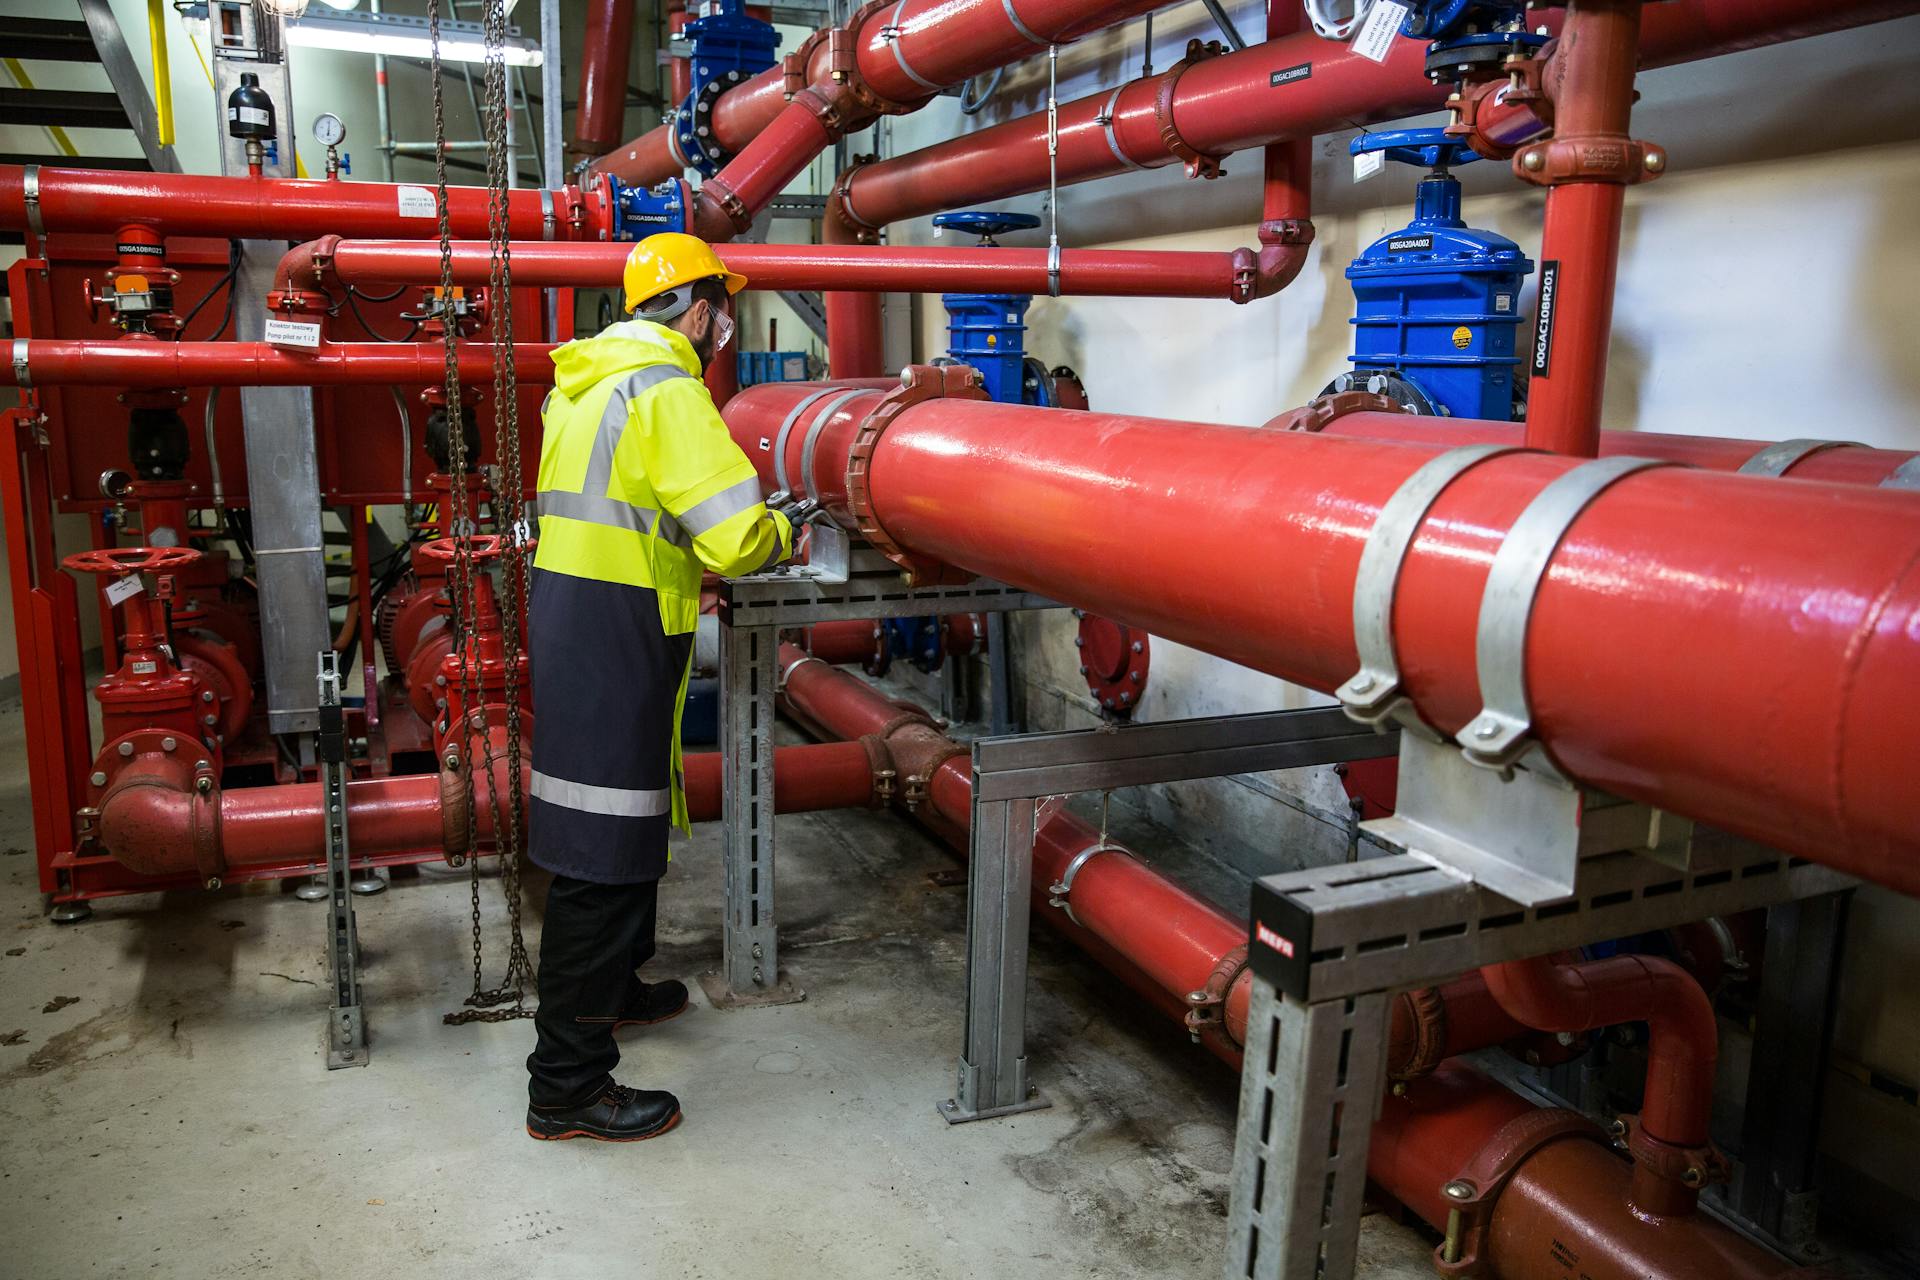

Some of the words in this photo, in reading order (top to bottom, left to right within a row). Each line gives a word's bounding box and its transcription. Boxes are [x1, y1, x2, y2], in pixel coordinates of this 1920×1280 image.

[1272, 67, 1309, 82] 00GAC10BR002
[1390, 239, 1430, 249] 00SGA20AA002
[1536, 269, 1554, 369] 00GAC10BR201
